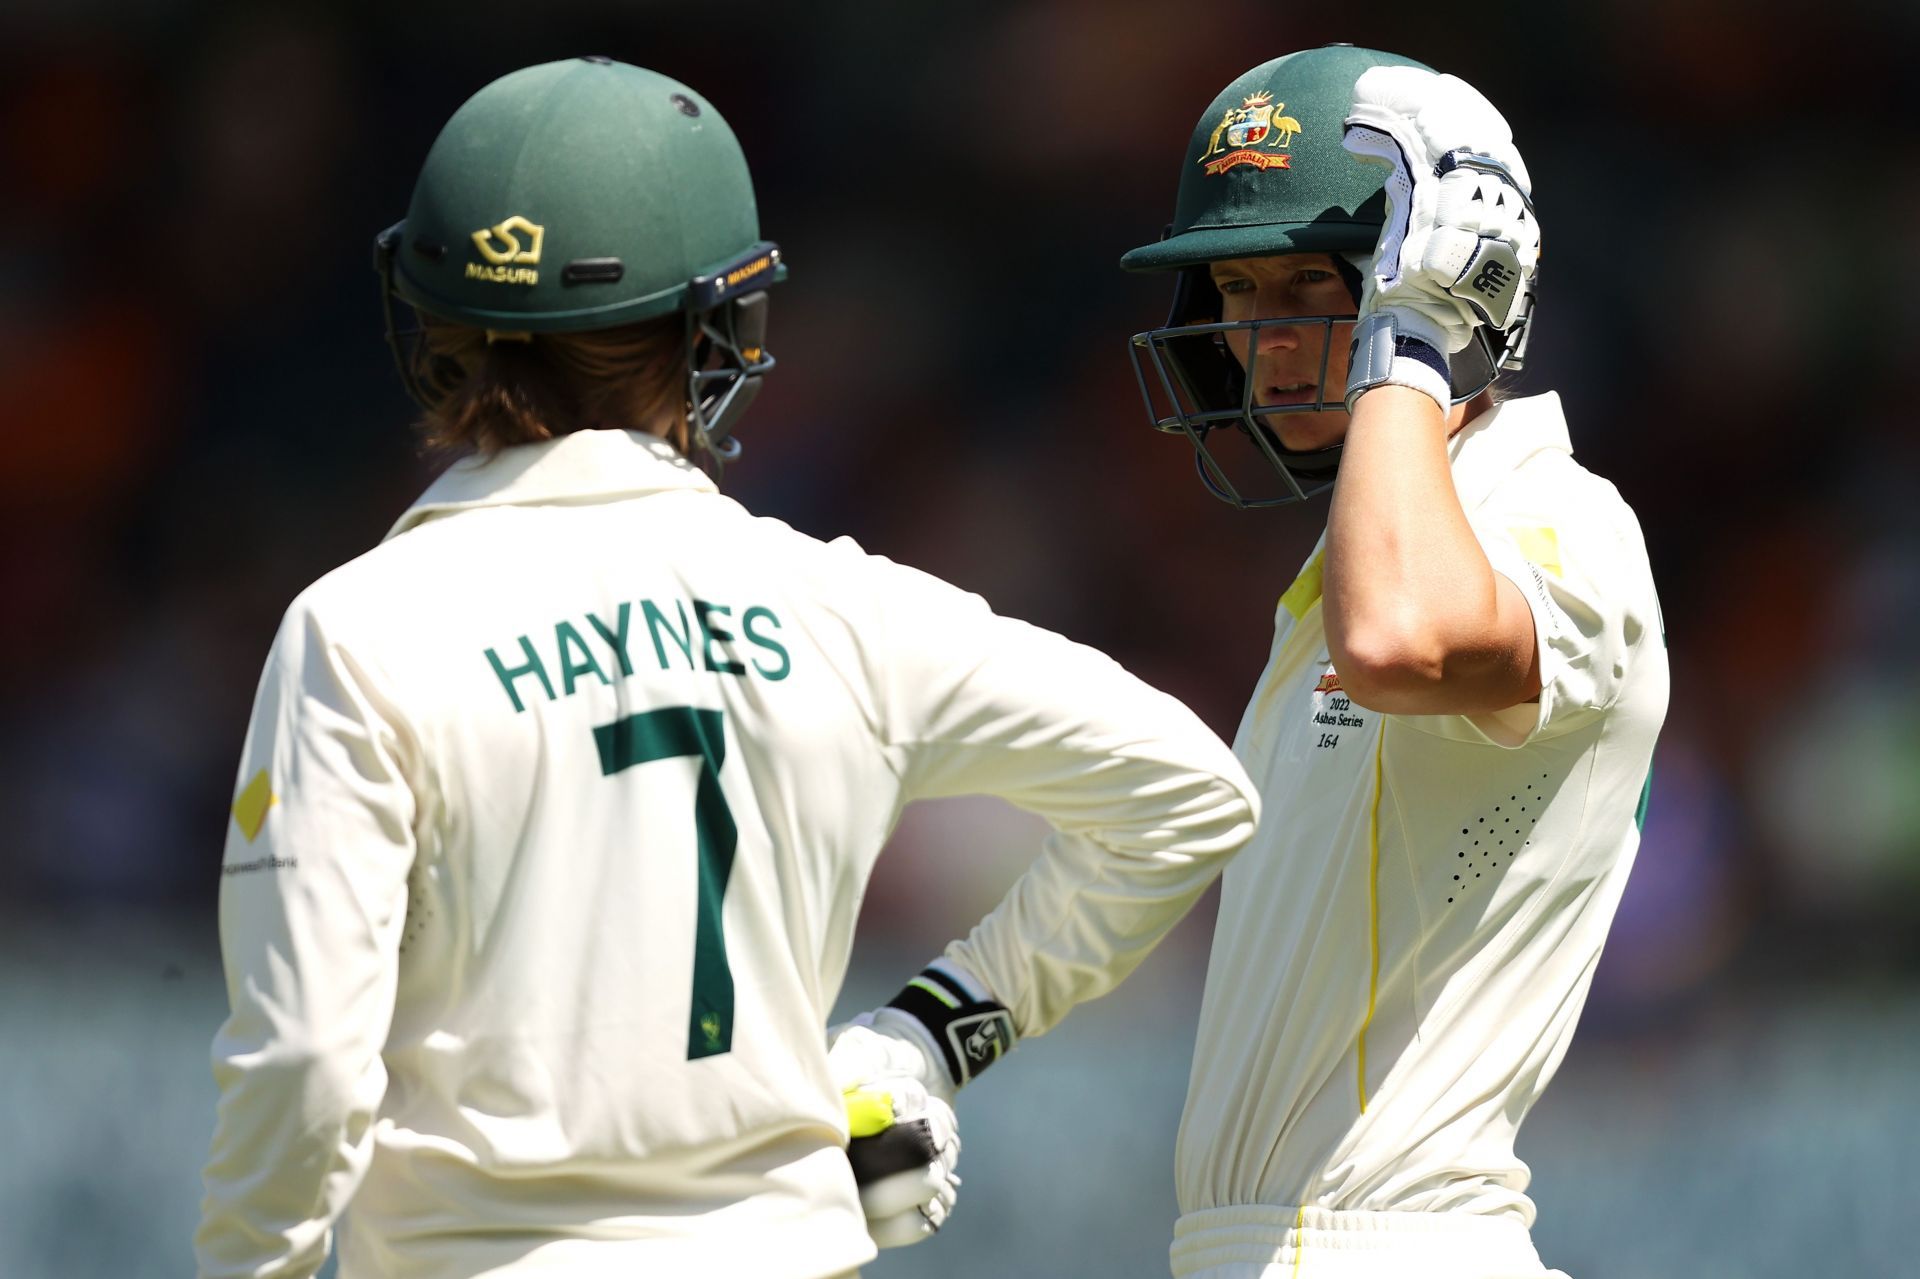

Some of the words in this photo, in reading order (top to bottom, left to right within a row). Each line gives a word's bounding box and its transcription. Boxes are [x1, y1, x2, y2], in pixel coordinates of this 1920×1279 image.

[465, 262, 538, 285] MASURI
[484, 598, 791, 713] HAYNES
[1330, 698, 1350, 711] 2022
[1313, 712, 1337, 726] Ashes
[1337, 713, 1364, 728] Series
[1317, 733, 1339, 749] 164
[592, 705, 738, 1060] 7
